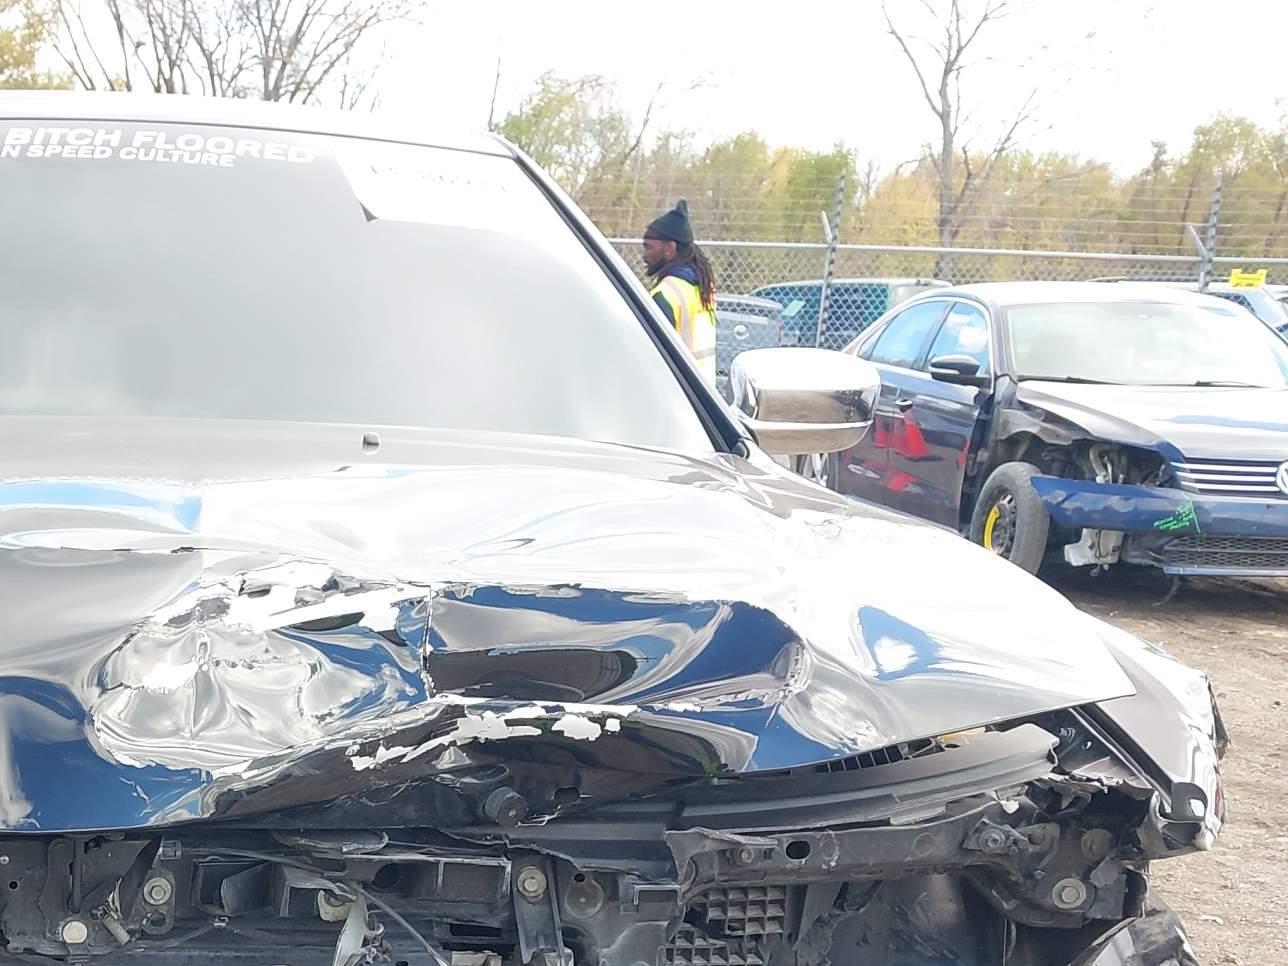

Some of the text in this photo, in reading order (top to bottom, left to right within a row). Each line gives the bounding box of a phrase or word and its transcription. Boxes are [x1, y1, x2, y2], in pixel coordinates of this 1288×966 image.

[4, 127, 123, 147] BITCH
[132, 130, 313, 164] FLOORED
[25, 144, 113, 159] SPEED
[119, 146, 237, 168] CULTURE
